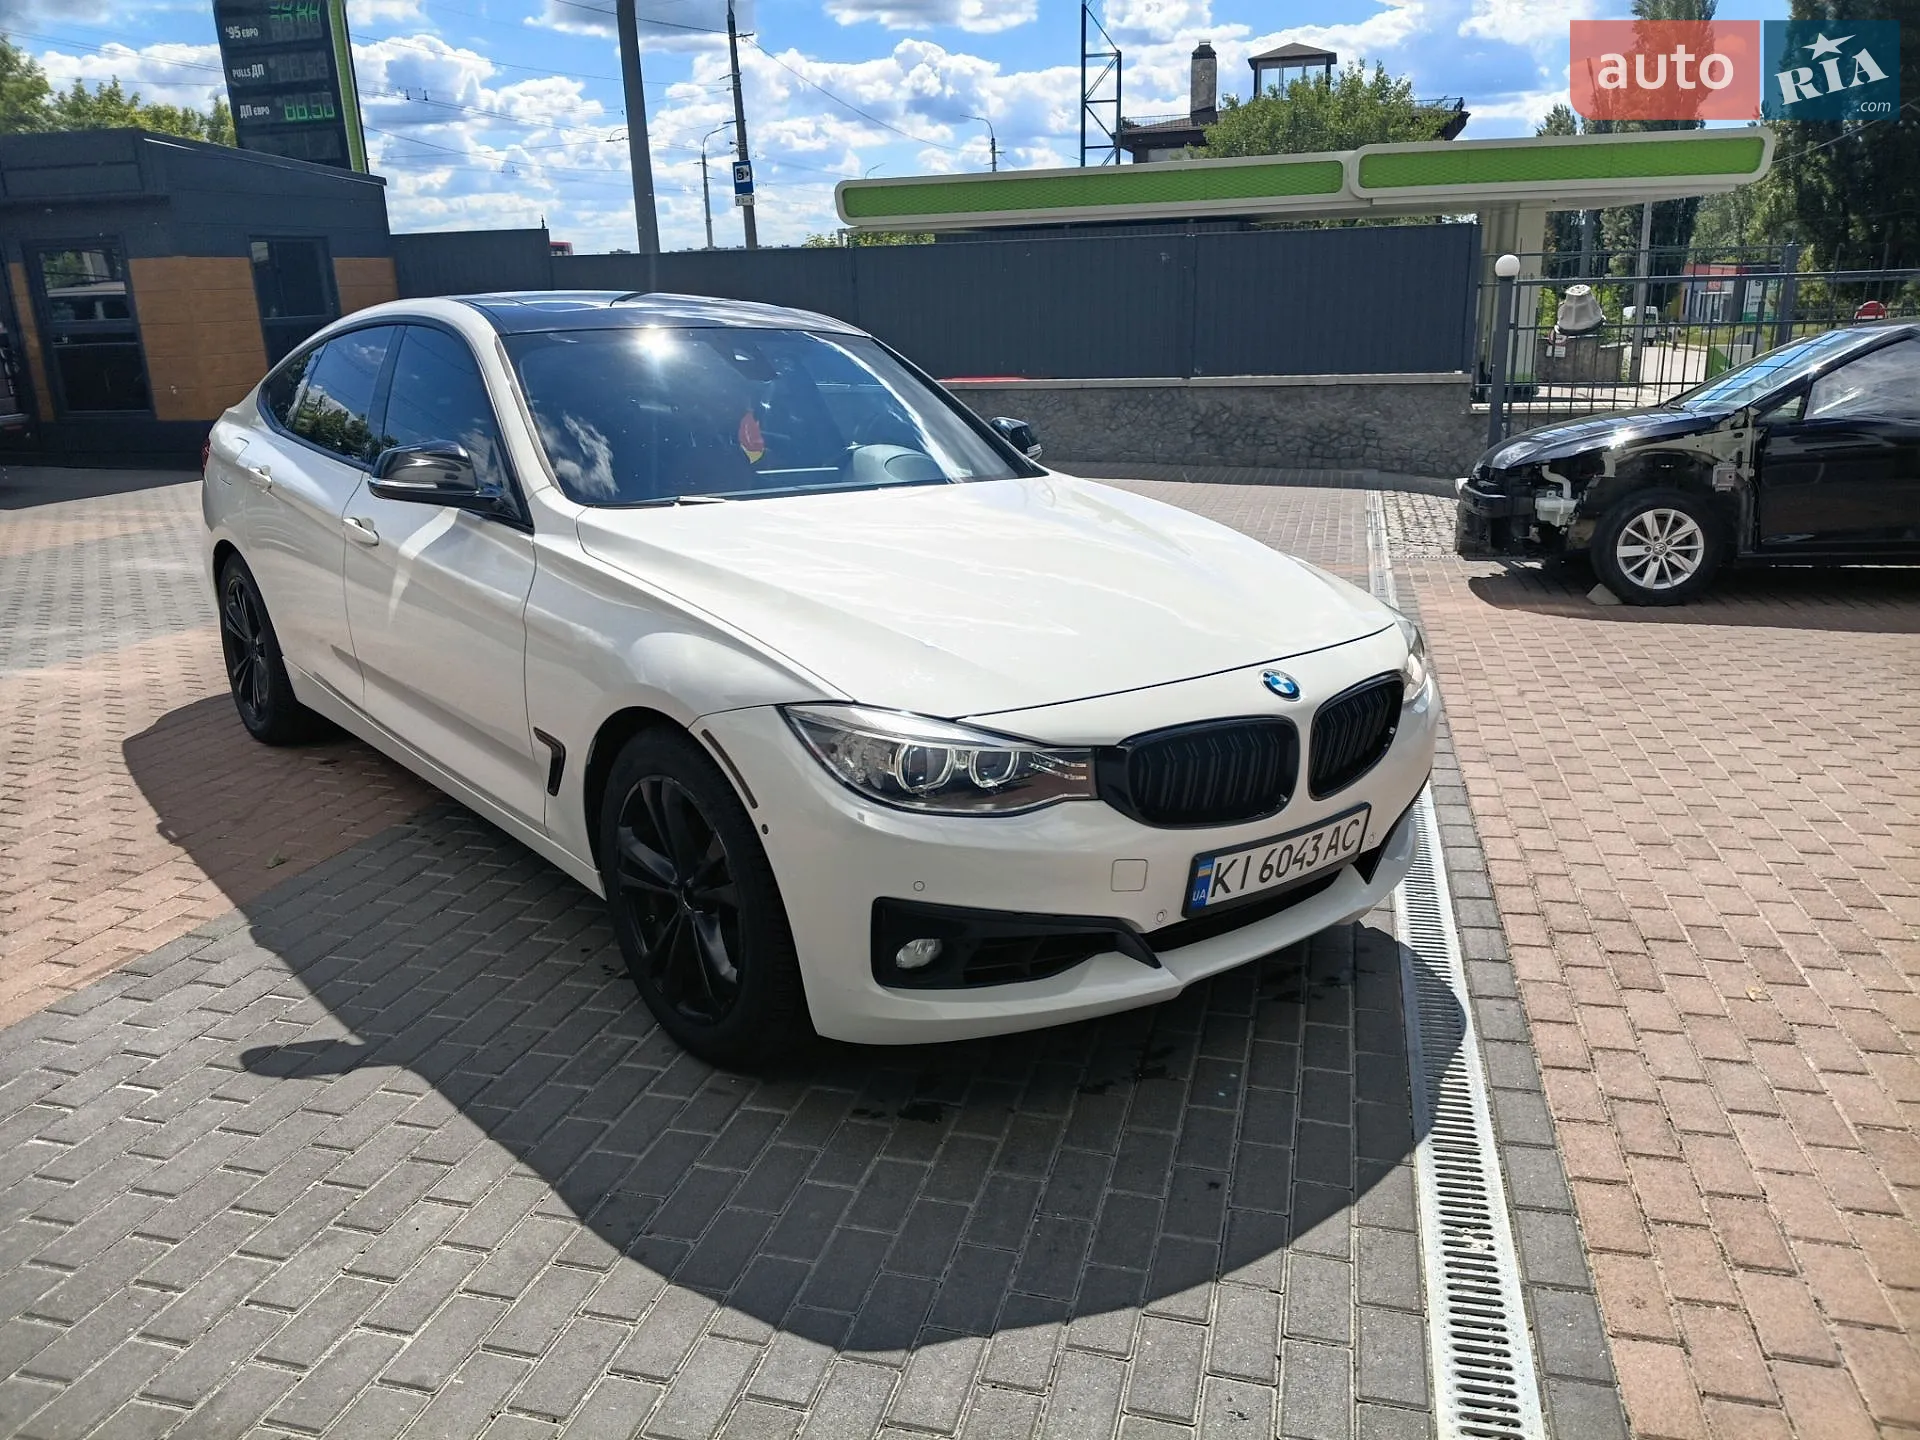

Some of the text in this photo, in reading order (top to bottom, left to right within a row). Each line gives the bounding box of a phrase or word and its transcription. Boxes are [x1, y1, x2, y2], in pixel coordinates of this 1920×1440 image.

[232, 67, 251, 79] PULLS
[1210, 818, 1360, 898] KI 6043 AC
[1192, 888, 1206, 902] UA
